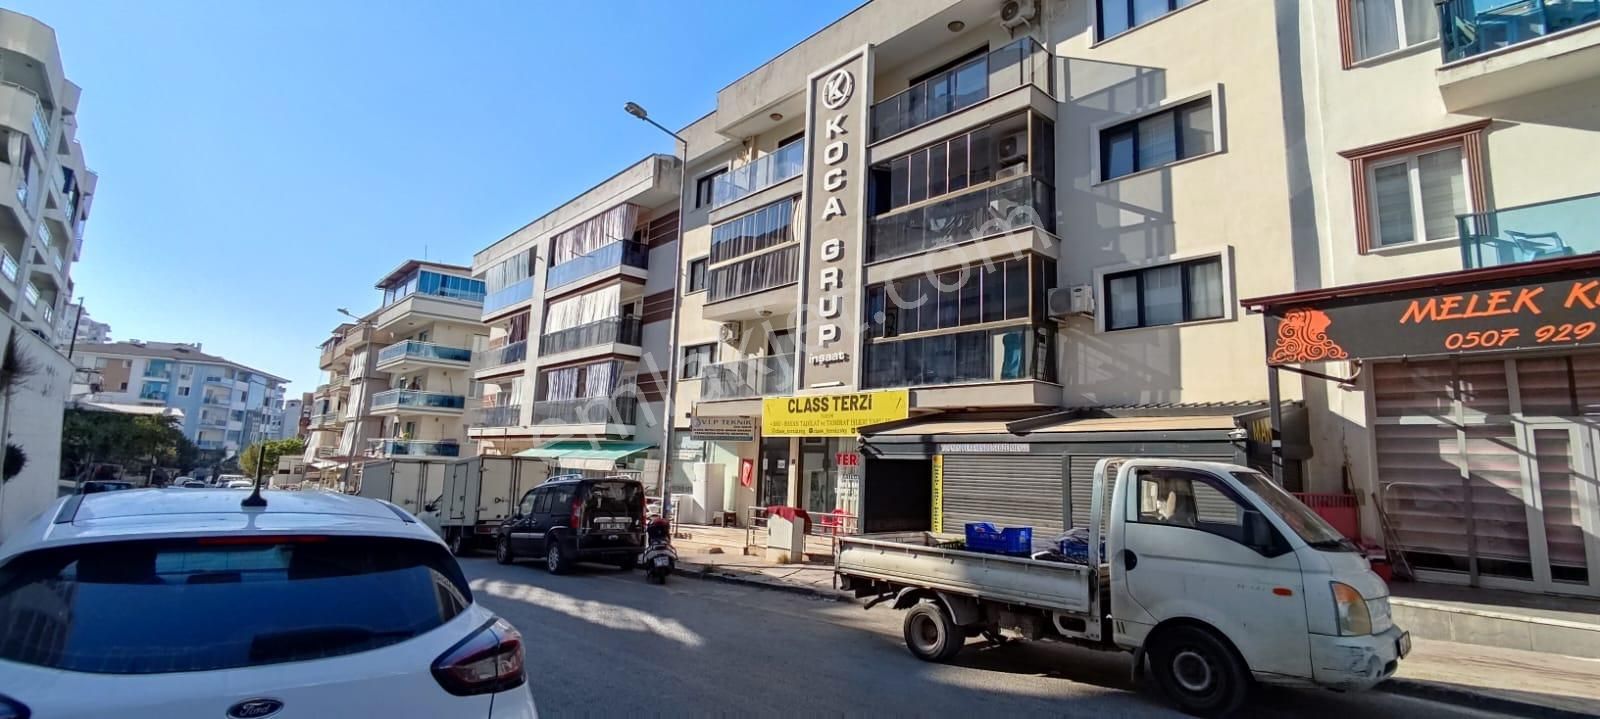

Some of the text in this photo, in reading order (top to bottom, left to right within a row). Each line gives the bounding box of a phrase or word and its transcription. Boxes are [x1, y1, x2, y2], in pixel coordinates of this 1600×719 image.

[818, 114, 846, 346] KOCA GRUP
[1400, 280, 1600, 324] MELEK K
[1445, 321, 1597, 350] 0507 929
[788, 398, 829, 413] CLASS
[835, 453, 859, 466] TER
[240, 702, 271, 716] Ford
